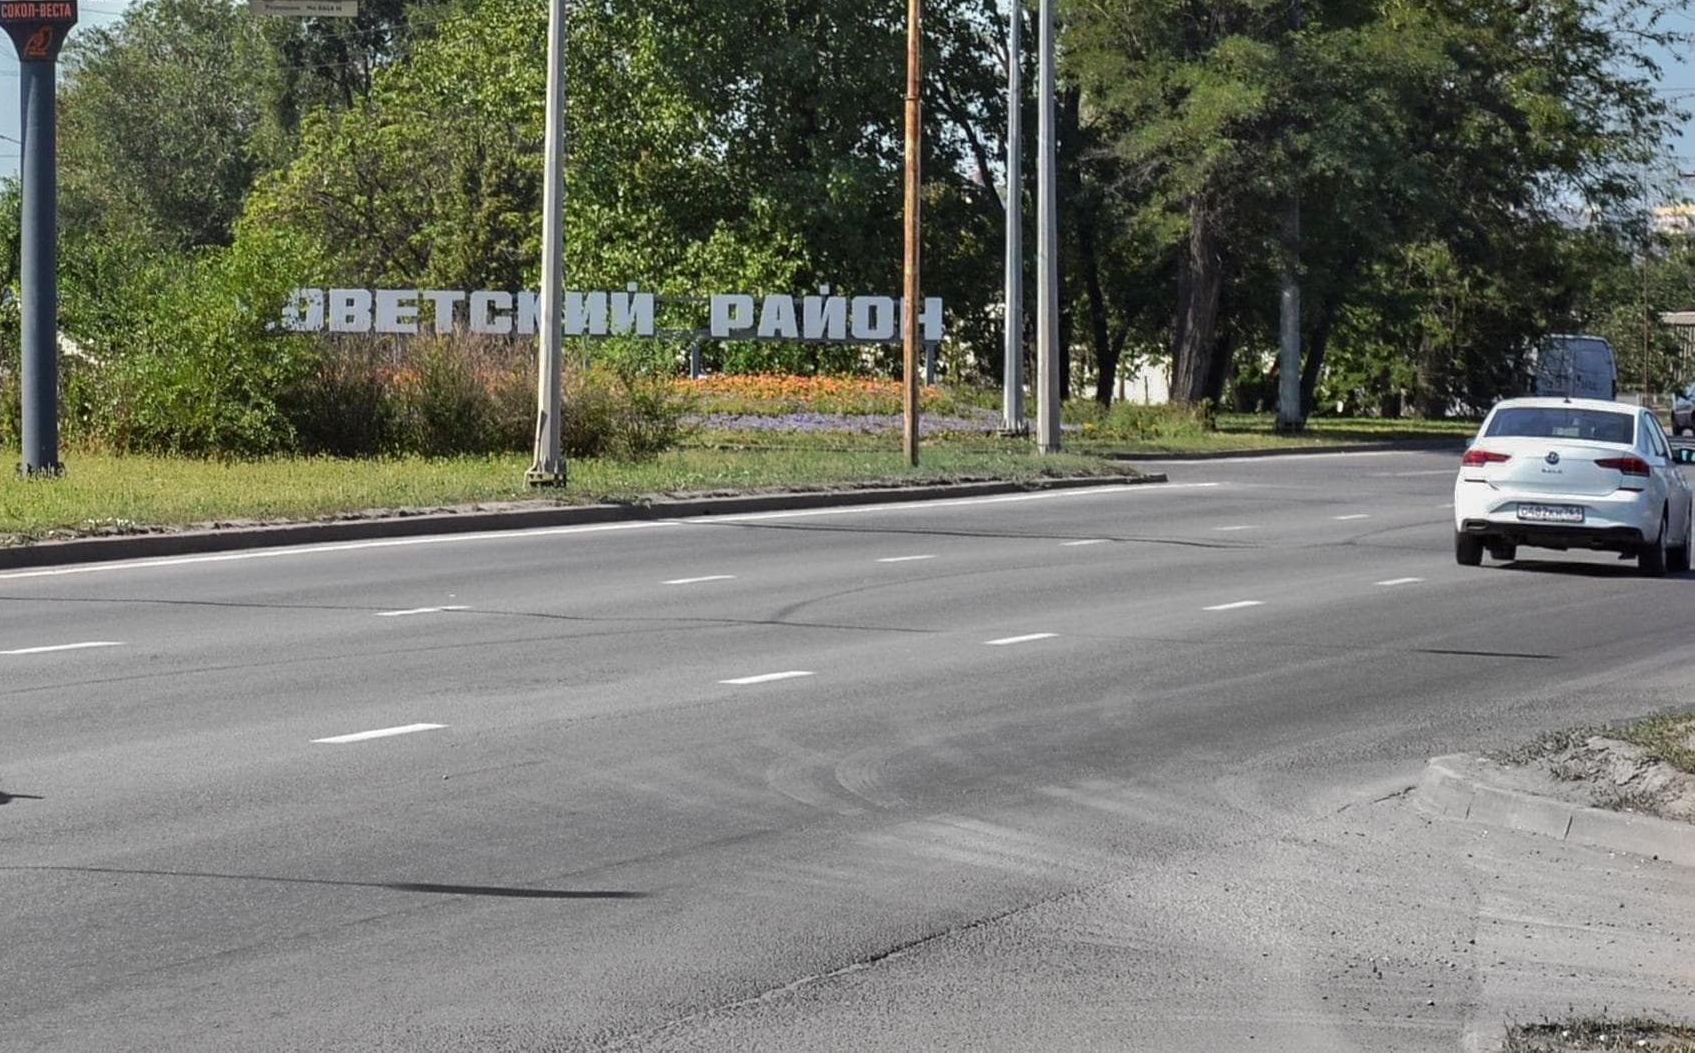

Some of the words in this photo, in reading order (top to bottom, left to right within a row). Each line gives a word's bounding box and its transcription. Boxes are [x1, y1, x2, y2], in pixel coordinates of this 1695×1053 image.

[1, 3, 72, 18] СОКОЛ-ВЕСТА
[265, 282, 654, 335] ОВЕТСКИЙ
[710, 285, 943, 340] РАЙОН
